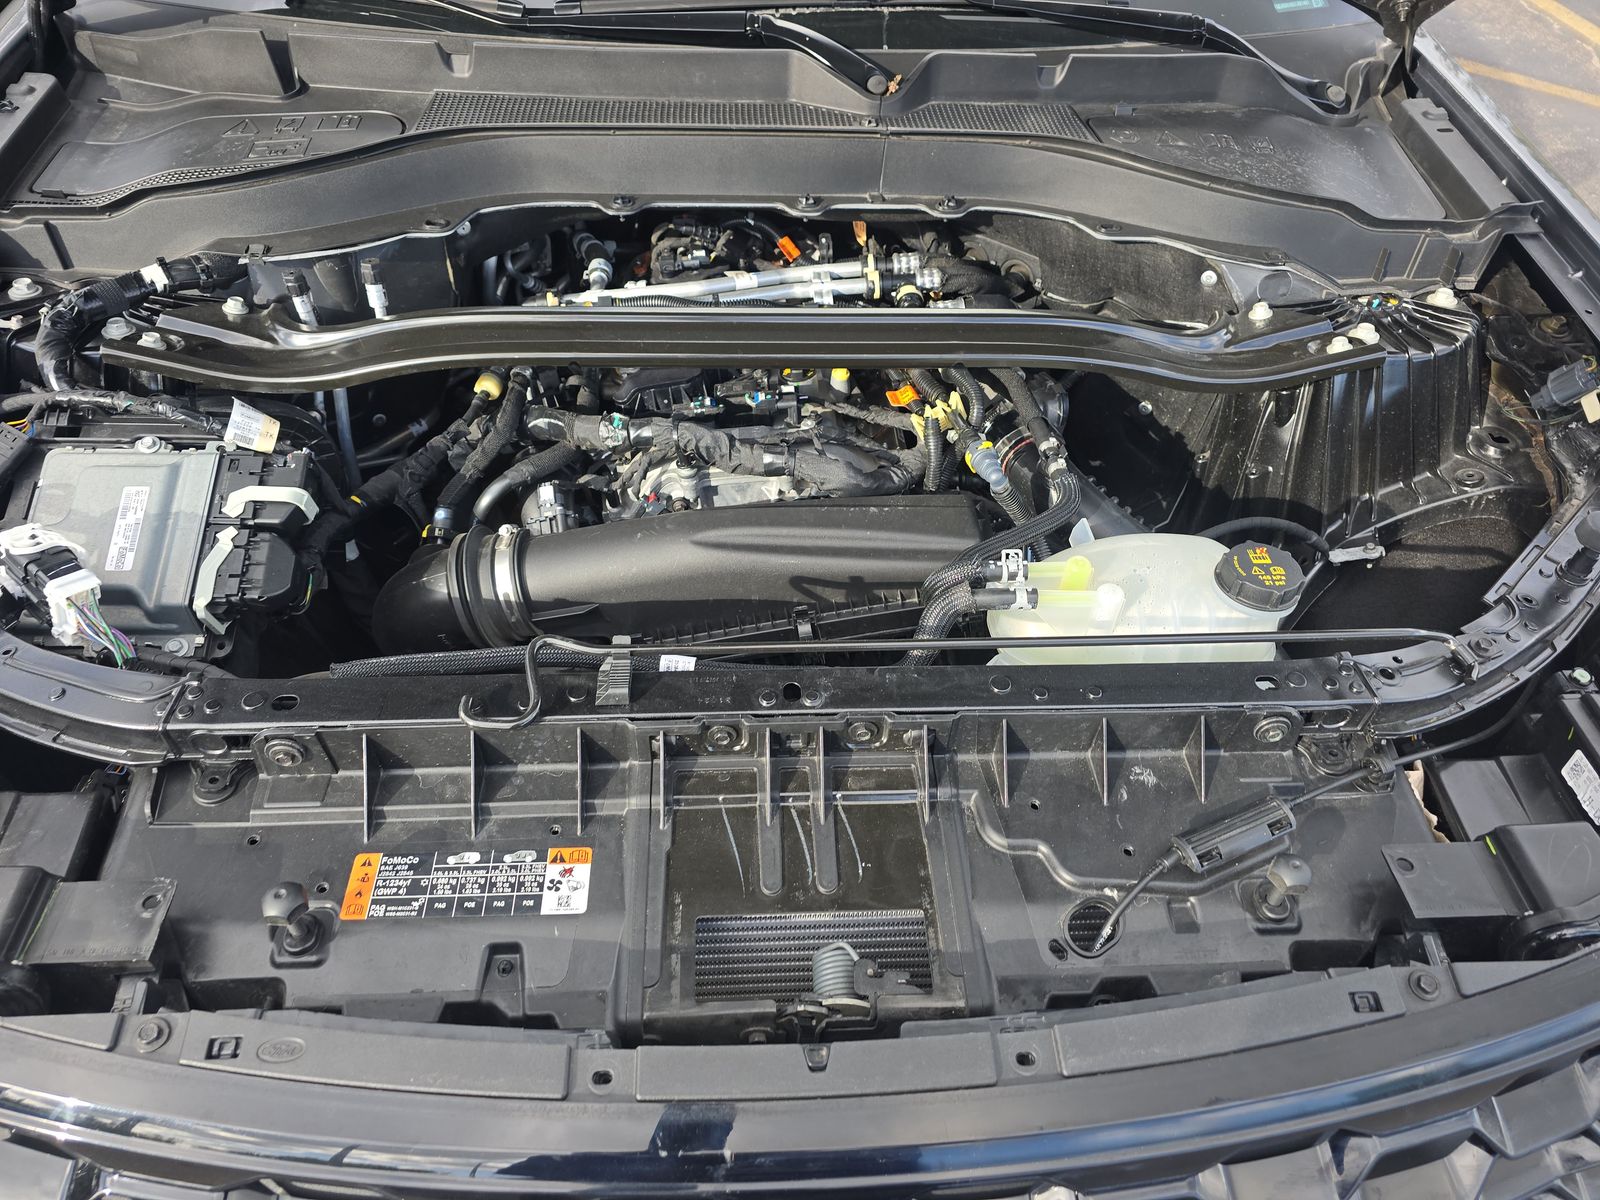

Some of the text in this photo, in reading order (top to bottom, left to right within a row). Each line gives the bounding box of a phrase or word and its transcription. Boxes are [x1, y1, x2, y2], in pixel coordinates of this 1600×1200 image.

[382, 856, 420, 864] FoMoCo
[376, 879, 412, 888] R-1234yf
[374, 887, 406, 896] (GWP 4)
[262, 1044, 297, 1057] Ford
